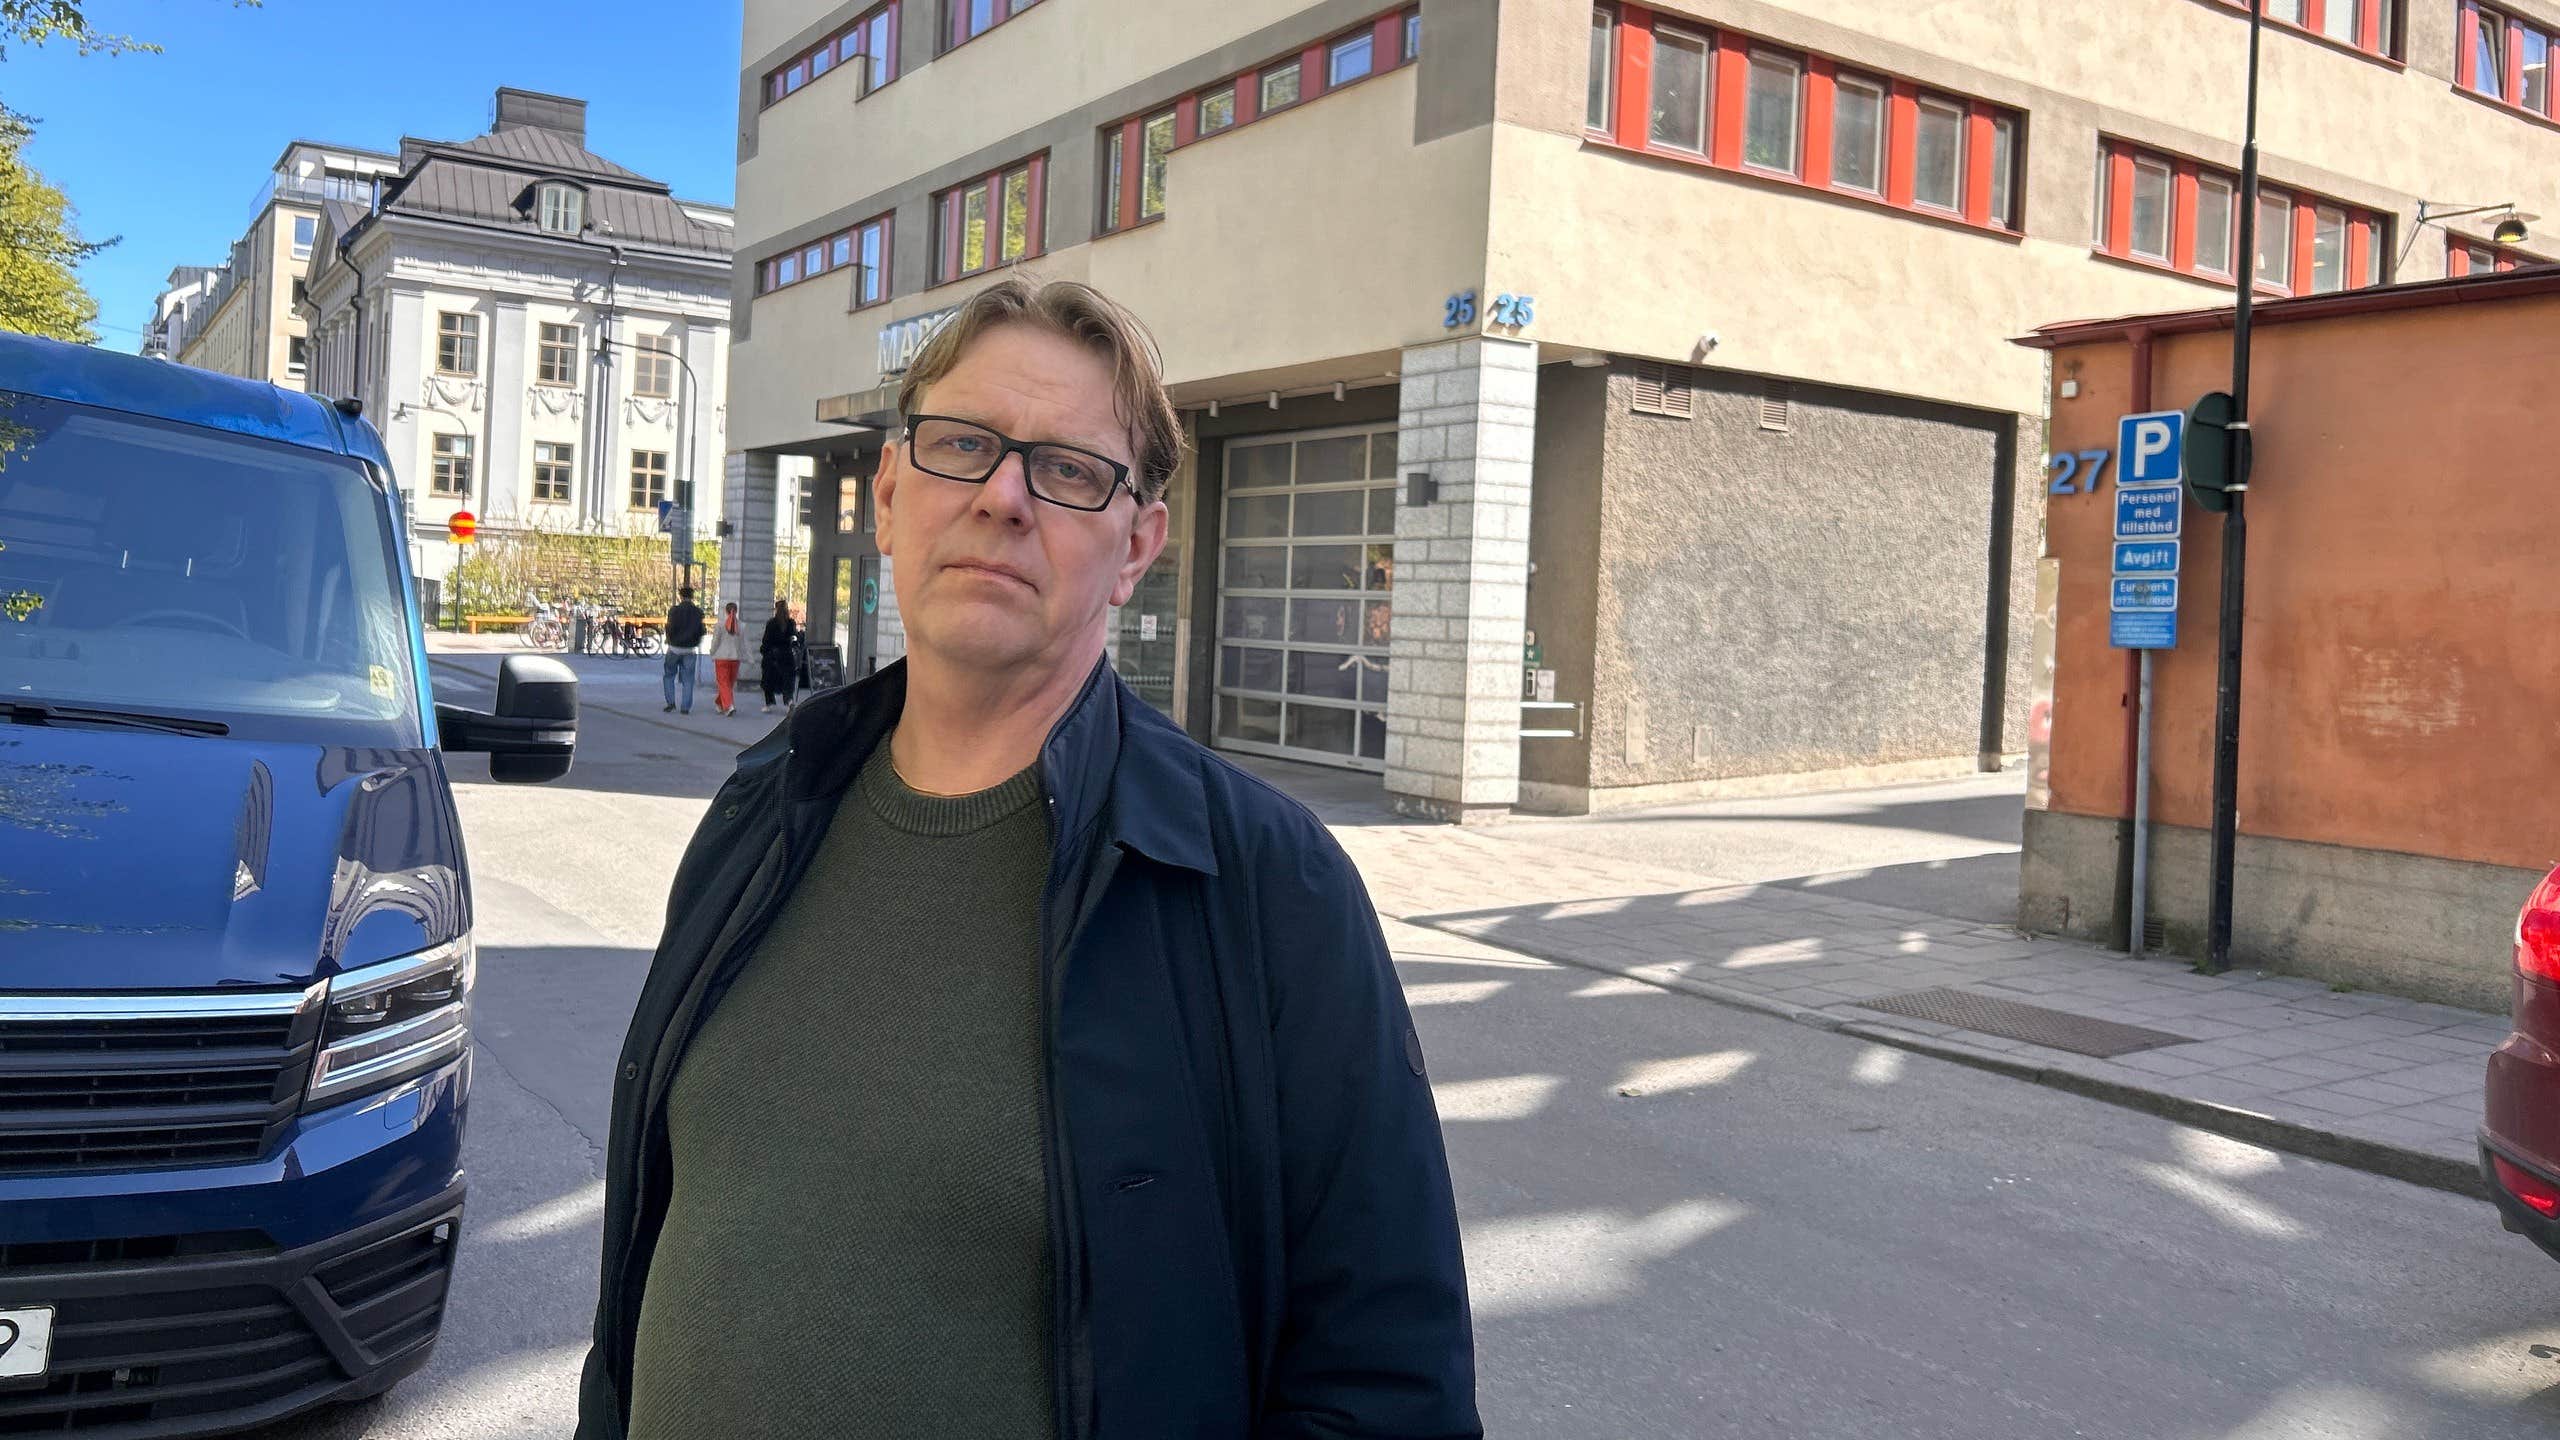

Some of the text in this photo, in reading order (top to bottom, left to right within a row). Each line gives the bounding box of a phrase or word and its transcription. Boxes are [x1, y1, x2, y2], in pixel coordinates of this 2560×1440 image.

[1443, 289, 1475, 327] 25
[1497, 294, 1533, 327] 25
[2134, 420, 2171, 478] P
[2050, 448, 2110, 494] 27
[2120, 489, 2176, 505] Personal
[2135, 506, 2161, 519] med
[2122, 519, 2173, 534] tillstånd
[2123, 549, 2169, 568] Avgift
